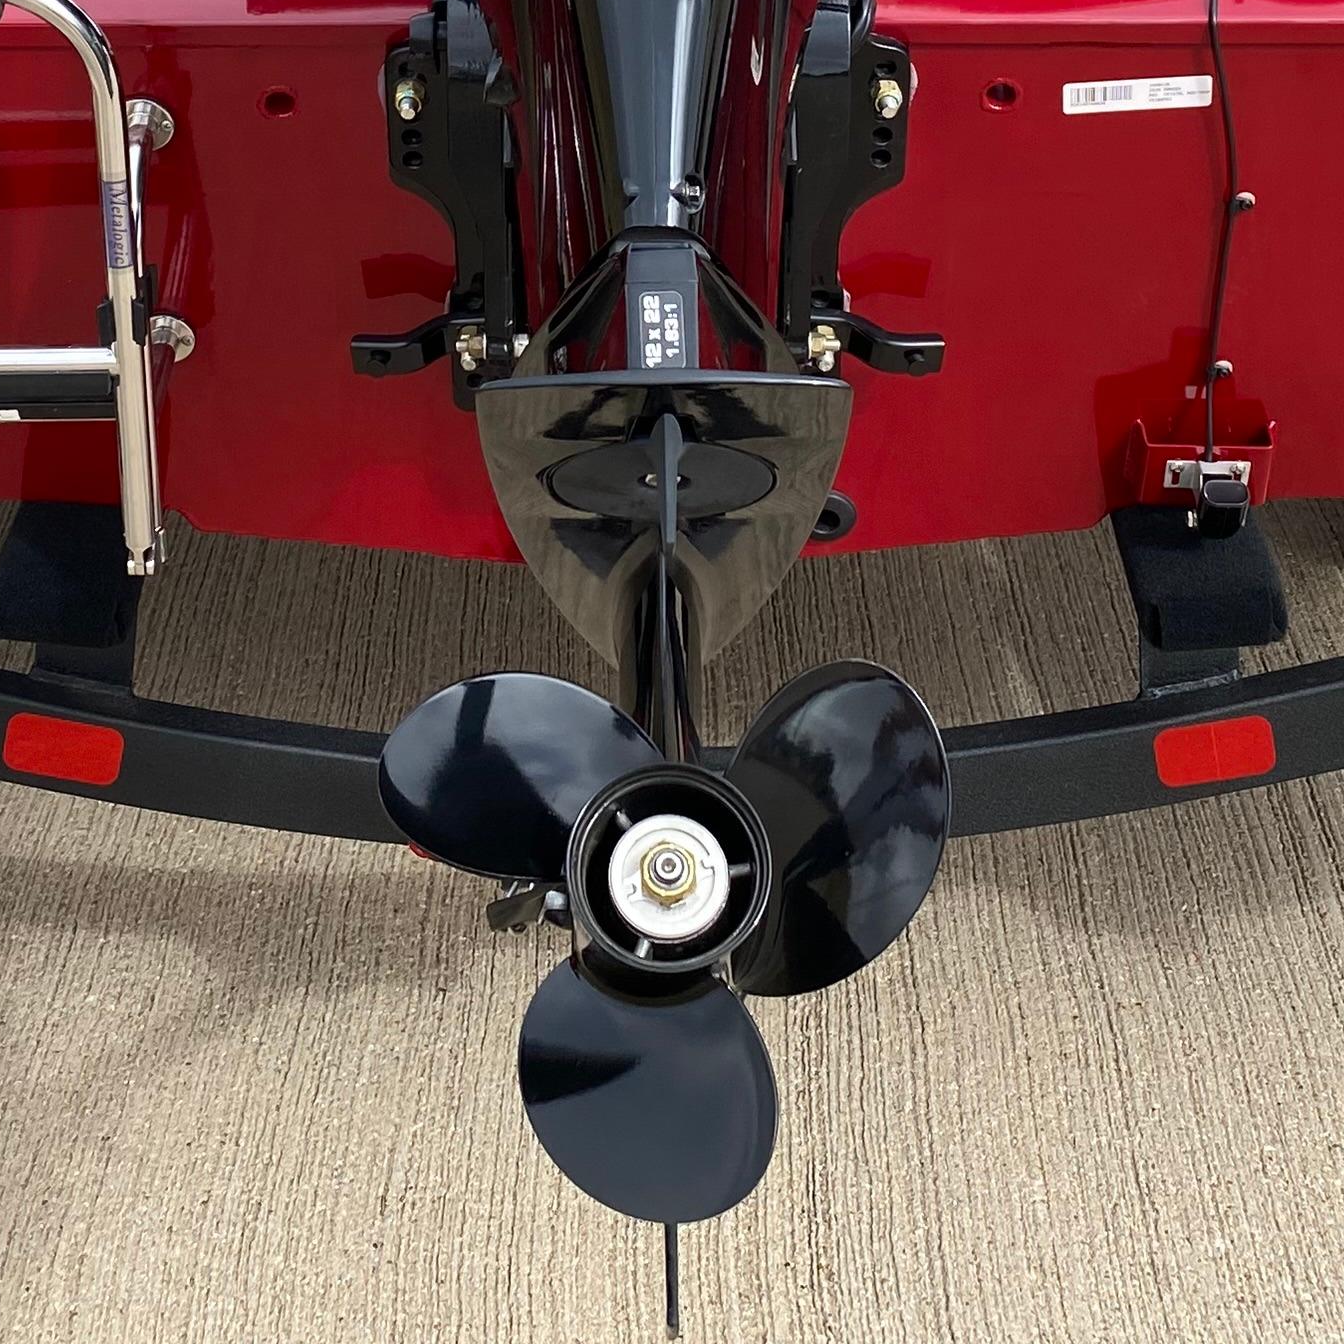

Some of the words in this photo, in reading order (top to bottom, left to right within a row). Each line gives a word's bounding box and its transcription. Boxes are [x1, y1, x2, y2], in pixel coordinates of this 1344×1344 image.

[109, 183, 128, 265] Metalogic
[642, 294, 660, 324] 22
[644, 343, 663, 368] 12
